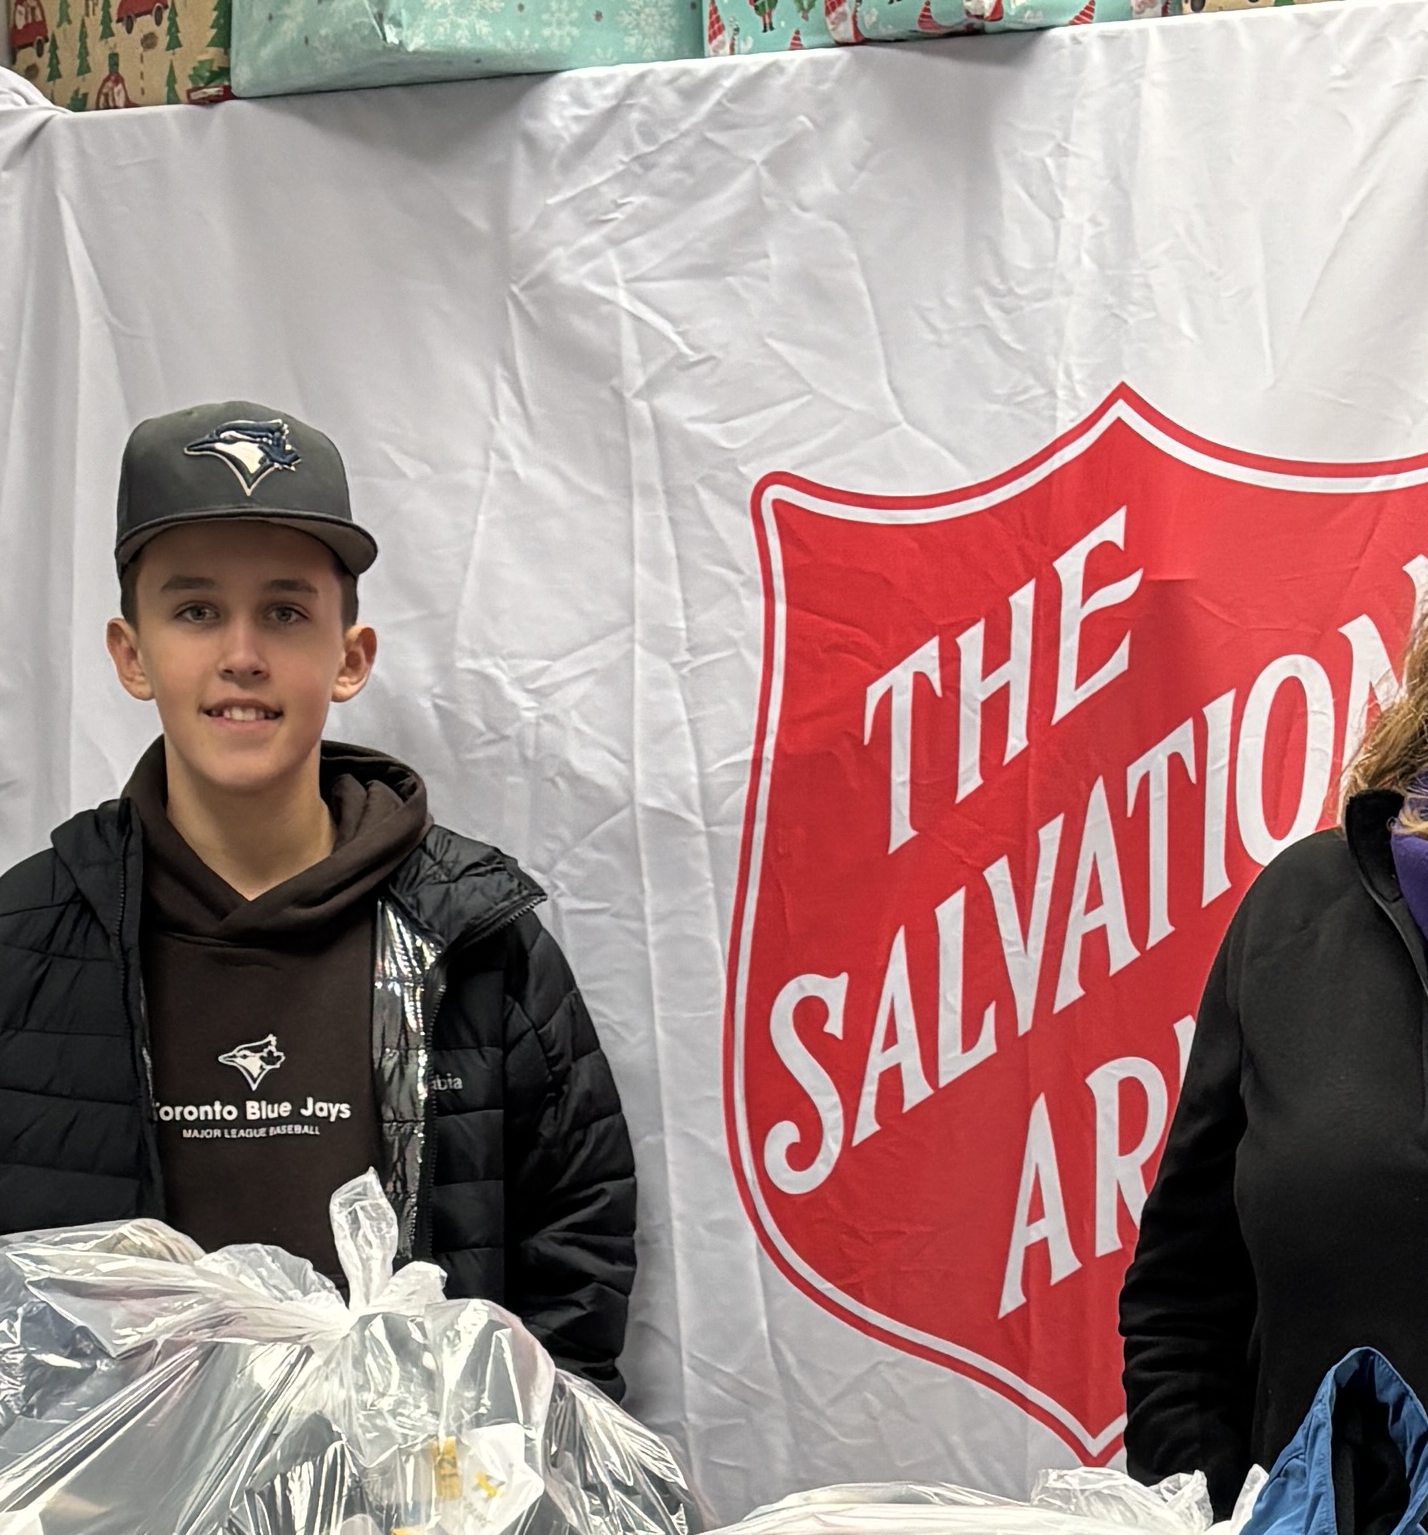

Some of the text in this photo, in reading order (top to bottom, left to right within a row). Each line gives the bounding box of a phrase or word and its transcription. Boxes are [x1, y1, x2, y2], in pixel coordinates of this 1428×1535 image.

[862, 504, 1146, 855] THE
[182, 1124, 320, 1139] MAJOR LEAGUE BASEBALL
[245, 1100, 292, 1120] Blue
[300, 1097, 351, 1122] Jays
[998, 1015, 1196, 1319] AR
